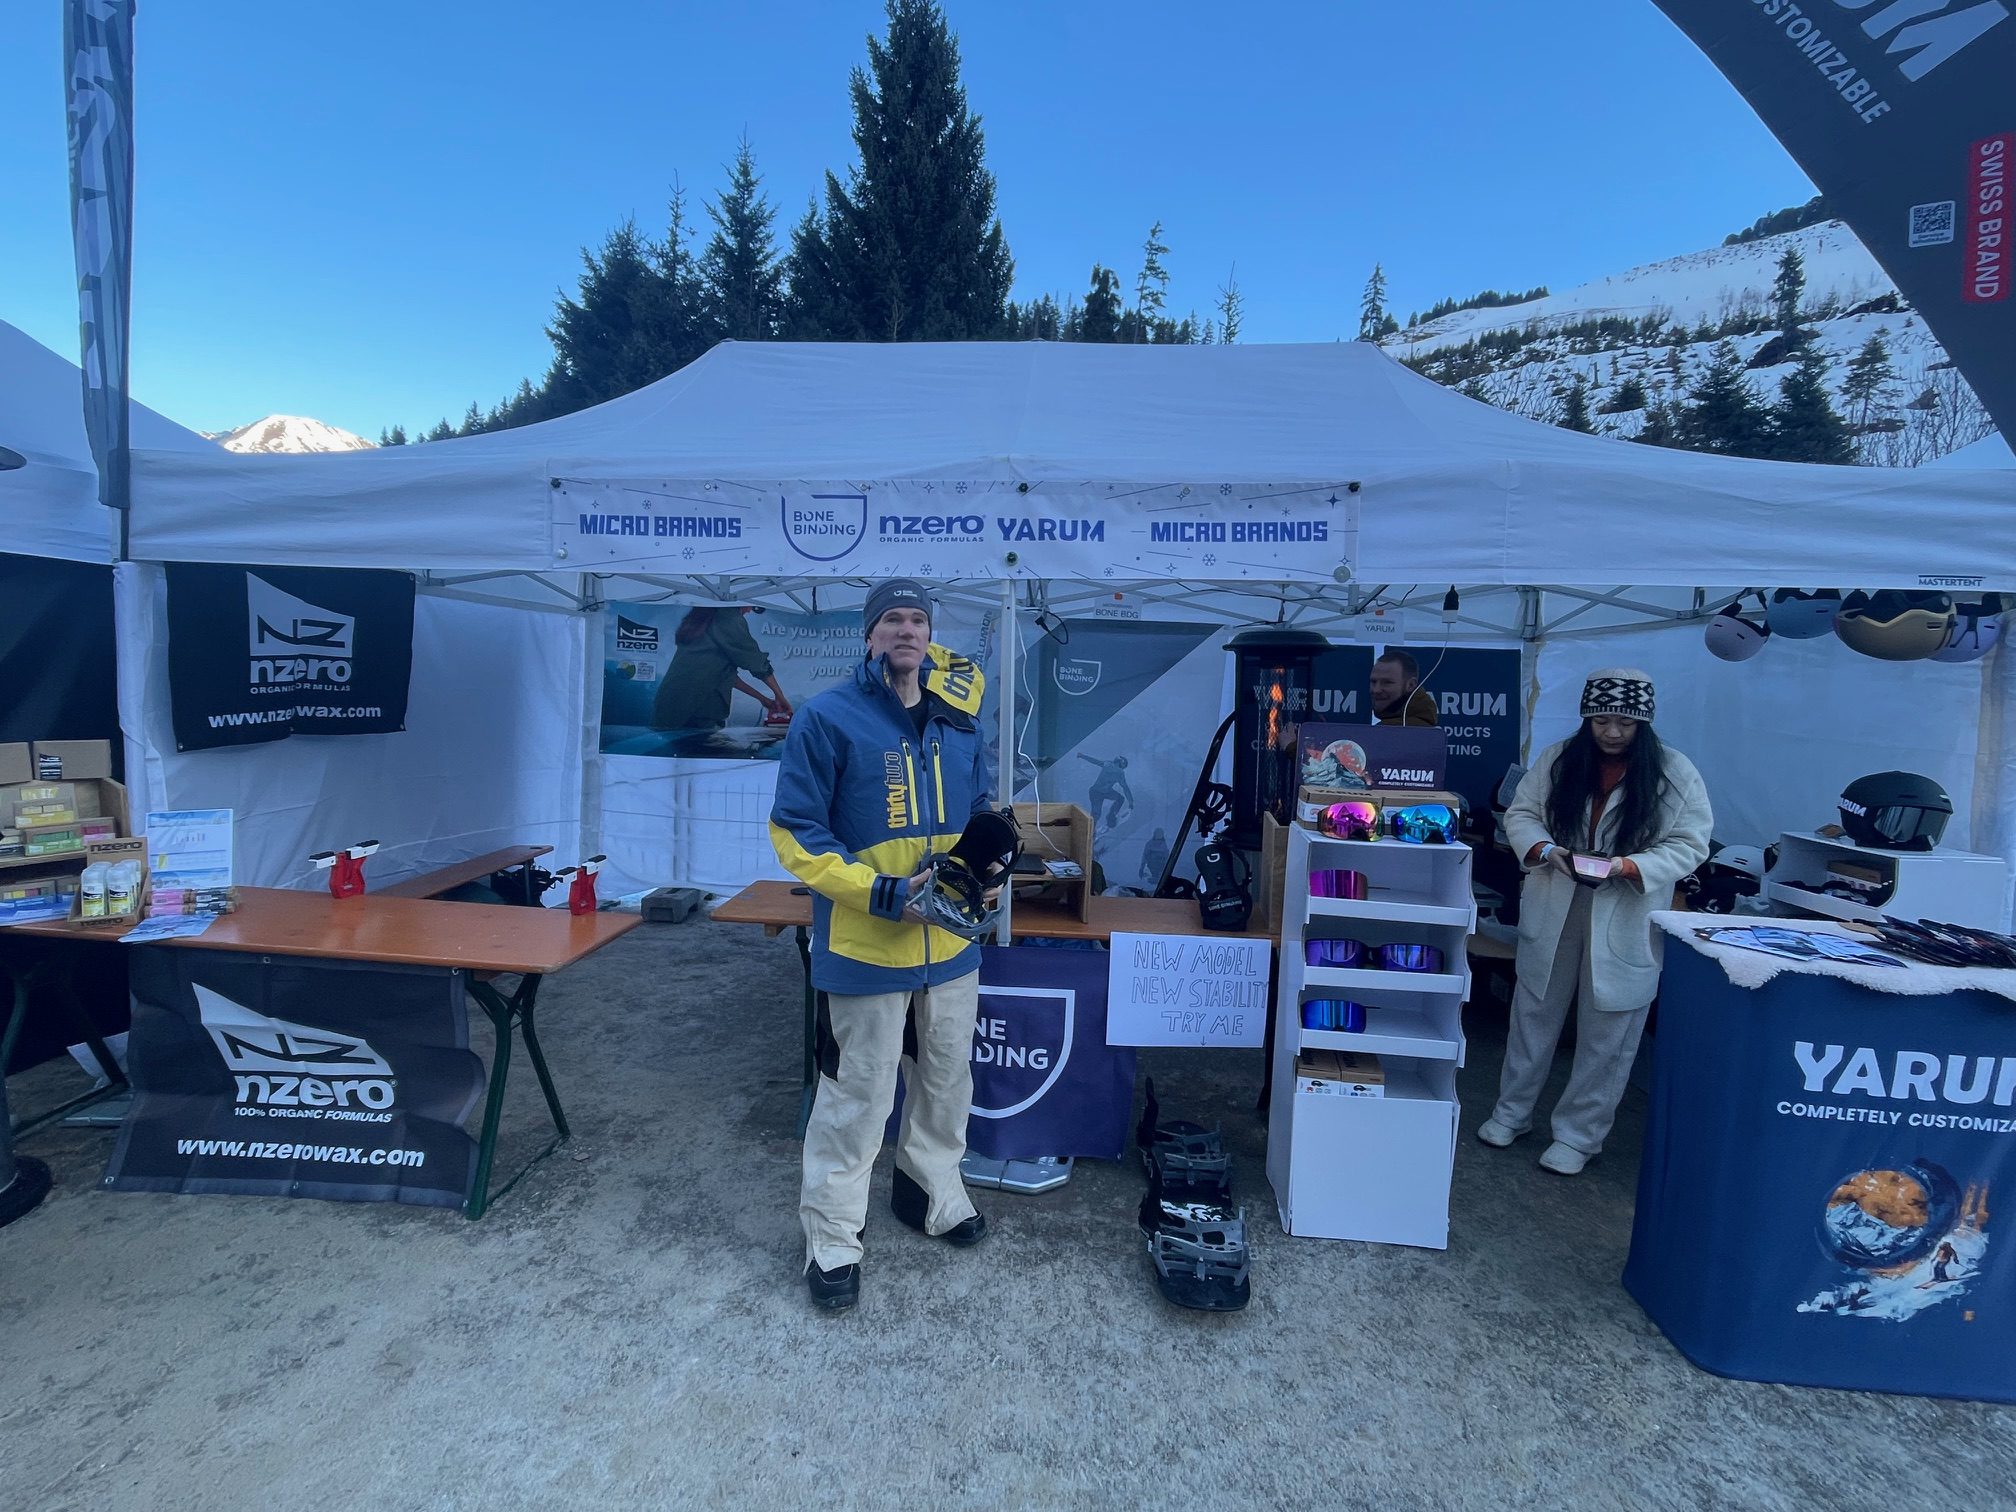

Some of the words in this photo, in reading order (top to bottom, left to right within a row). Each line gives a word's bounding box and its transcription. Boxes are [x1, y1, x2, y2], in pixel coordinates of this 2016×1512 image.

[1752, 0, 1892, 124] STOMIZABLE
[1979, 139, 2005, 215] SWISS
[1974, 217, 2004, 299] BRAND
[579, 513, 650, 536] MICRO
[653, 516, 742, 538] BRANDS
[793, 510, 835, 522] BONE
[879, 514, 985, 535] nzero
[793, 523, 856, 536] BINDING
[997, 517, 1105, 542] YARUM
[1151, 521, 1226, 543] MICRO
[1231, 521, 1328, 543] BRANDS
[1918, 578, 1983, 587] MASTERTENT
[1095, 608, 1119, 617] BONE
[761, 621, 785, 636] Are
[791, 625, 817, 641] you
[821, 622, 865, 641] protec
[1365, 625, 1396, 633] YARUM
[616, 641, 658, 651] nzero
[783, 645, 818, 660] your
[250, 658, 352, 684] nzero
[809, 664, 842, 681] your
[1059, 666, 1083, 675] BONE
[1059, 673, 1095, 683] BINDING
[295, 682, 351, 692] ORMULAS
[1425, 691, 1507, 716] RUM
[208, 705, 382, 728] www.nzewax.com
[1435, 726, 1491, 738] DUCTS
[1381, 767, 1435, 782] YARUM
[90, 841, 143, 853] nzero
[1133, 940, 1185, 972] NEW
[1190, 944, 1257, 977] MODEL
[1131, 976, 1185, 1005] NEW
[1188, 978, 1270, 1009] STABILITY
[1161, 1010, 1206, 1034] TRY
[1209, 1014, 1244, 1036] ME
[234, 1075, 395, 1110] nzero
[234, 1107, 266, 1118] 100%
[269, 1108, 324, 1119] ORGANC
[324, 1110, 393, 1123] FORMULAS
[1776, 1101, 1902, 1125] COMPLETELY
[177, 1139, 425, 1168] www.nzerowax.com
